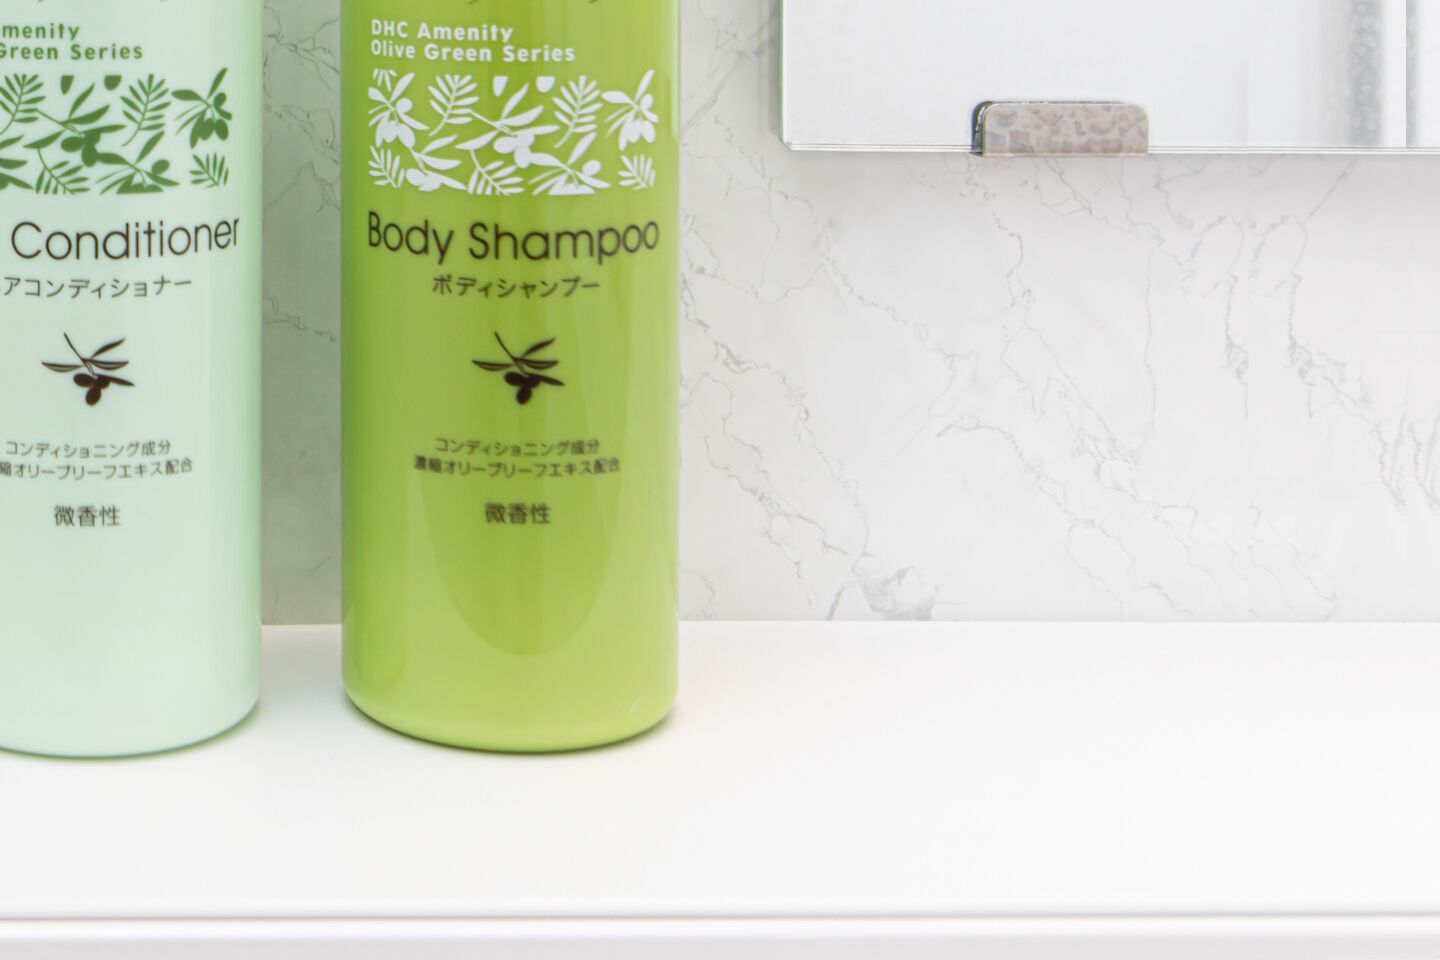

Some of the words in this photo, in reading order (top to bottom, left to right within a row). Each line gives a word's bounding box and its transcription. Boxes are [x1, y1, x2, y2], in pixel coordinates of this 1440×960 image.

[371, 18, 409, 38] DHC
[417, 22, 514, 42] Amenity
[70, 43, 143, 61] Series
[370, 39, 416, 58] Olive
[424, 43, 493, 62] Green
[502, 45, 576, 63] Series
[11, 217, 240, 261] Conditioner
[368, 210, 455, 266] Body
[468, 221, 659, 265] Shampoo
[432, 274, 600, 299] ボディシャンプー
[5, 439, 172, 459] コンディショニング成分
[435, 437, 600, 457] コンディショニング成分
[53, 504, 121, 528] 微香性
[484, 502, 551, 525] 微香性
